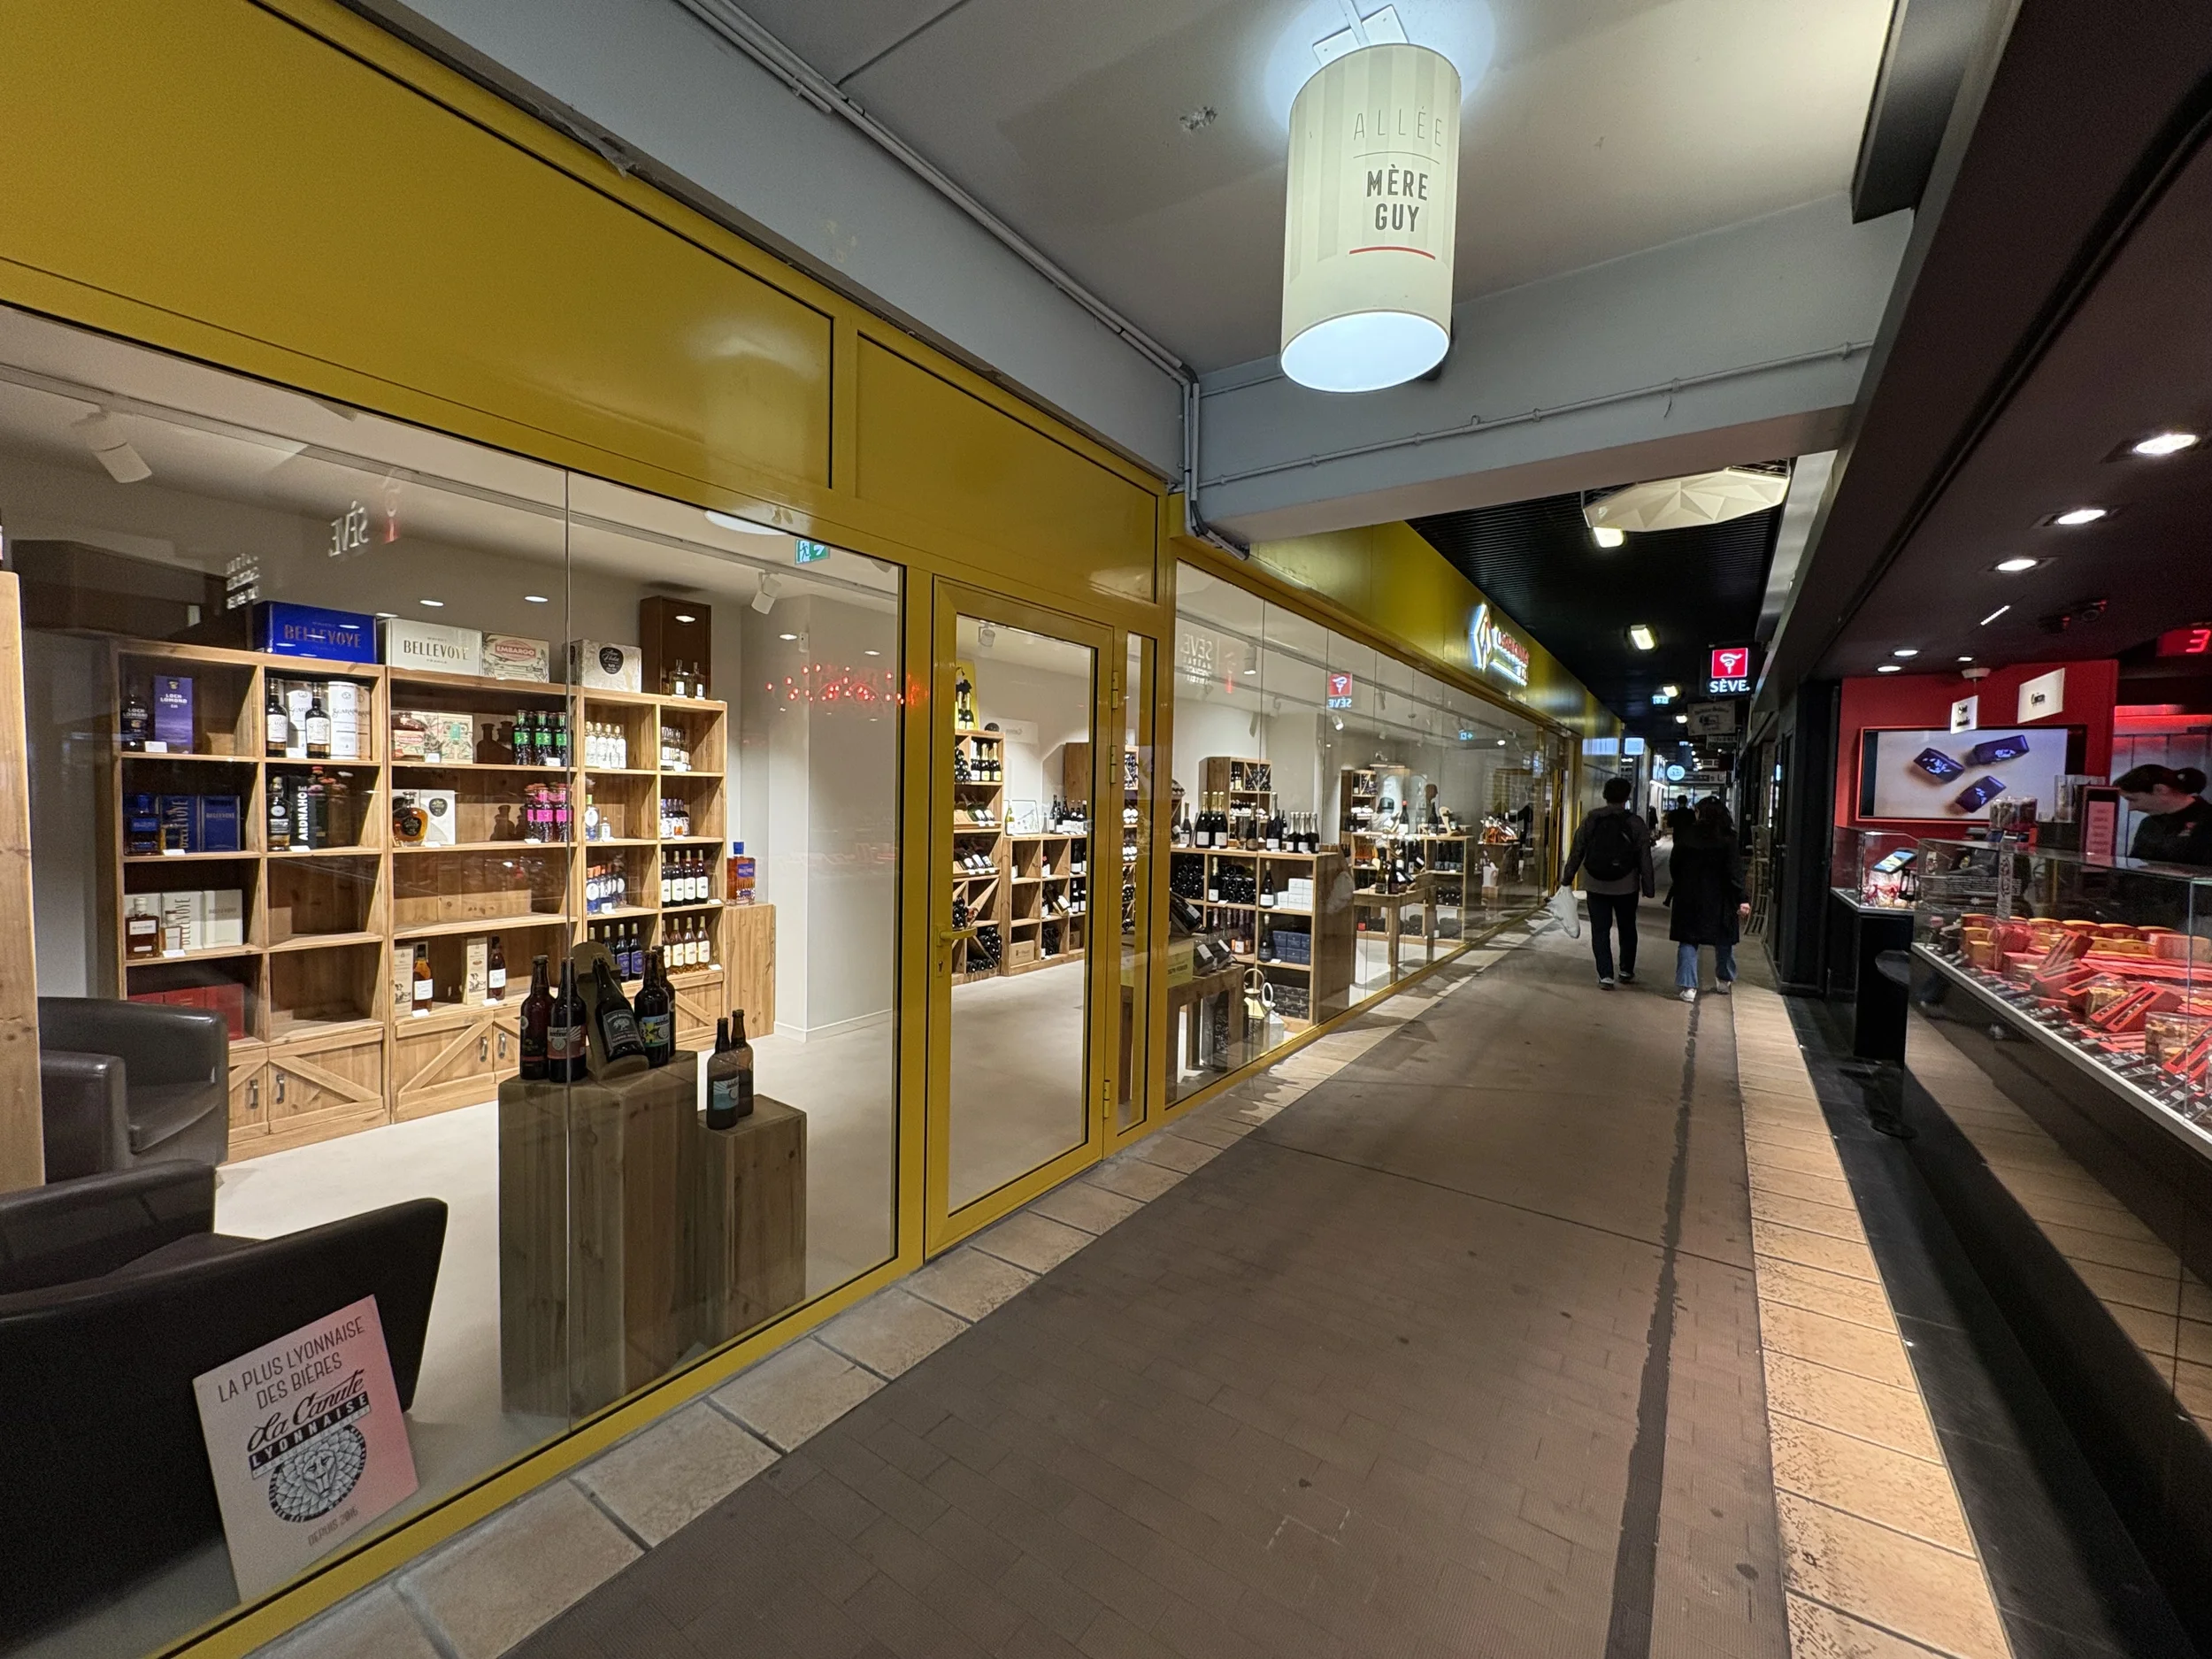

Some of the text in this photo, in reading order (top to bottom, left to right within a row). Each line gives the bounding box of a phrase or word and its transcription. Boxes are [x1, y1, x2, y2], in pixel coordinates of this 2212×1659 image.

[1354, 106, 1442, 147] ALLÉE
[1366, 164, 1428, 201] MÈRE
[1375, 203, 1419, 232] GUY
[284, 624, 361, 649] BELLEVOYE
[403, 640, 471, 661] BELLEVOYE
[496, 646, 535, 656] EMBARGO
[297, 786, 308, 841] ARDNAHOE
[218, 1316, 365, 1402] LA PLUS LYONNAISE
[257, 1352, 342, 1409] DES BIÈRES
[247, 1369, 365, 1453] La Canute
[252, 1397, 367, 1469] LYONNAISE
